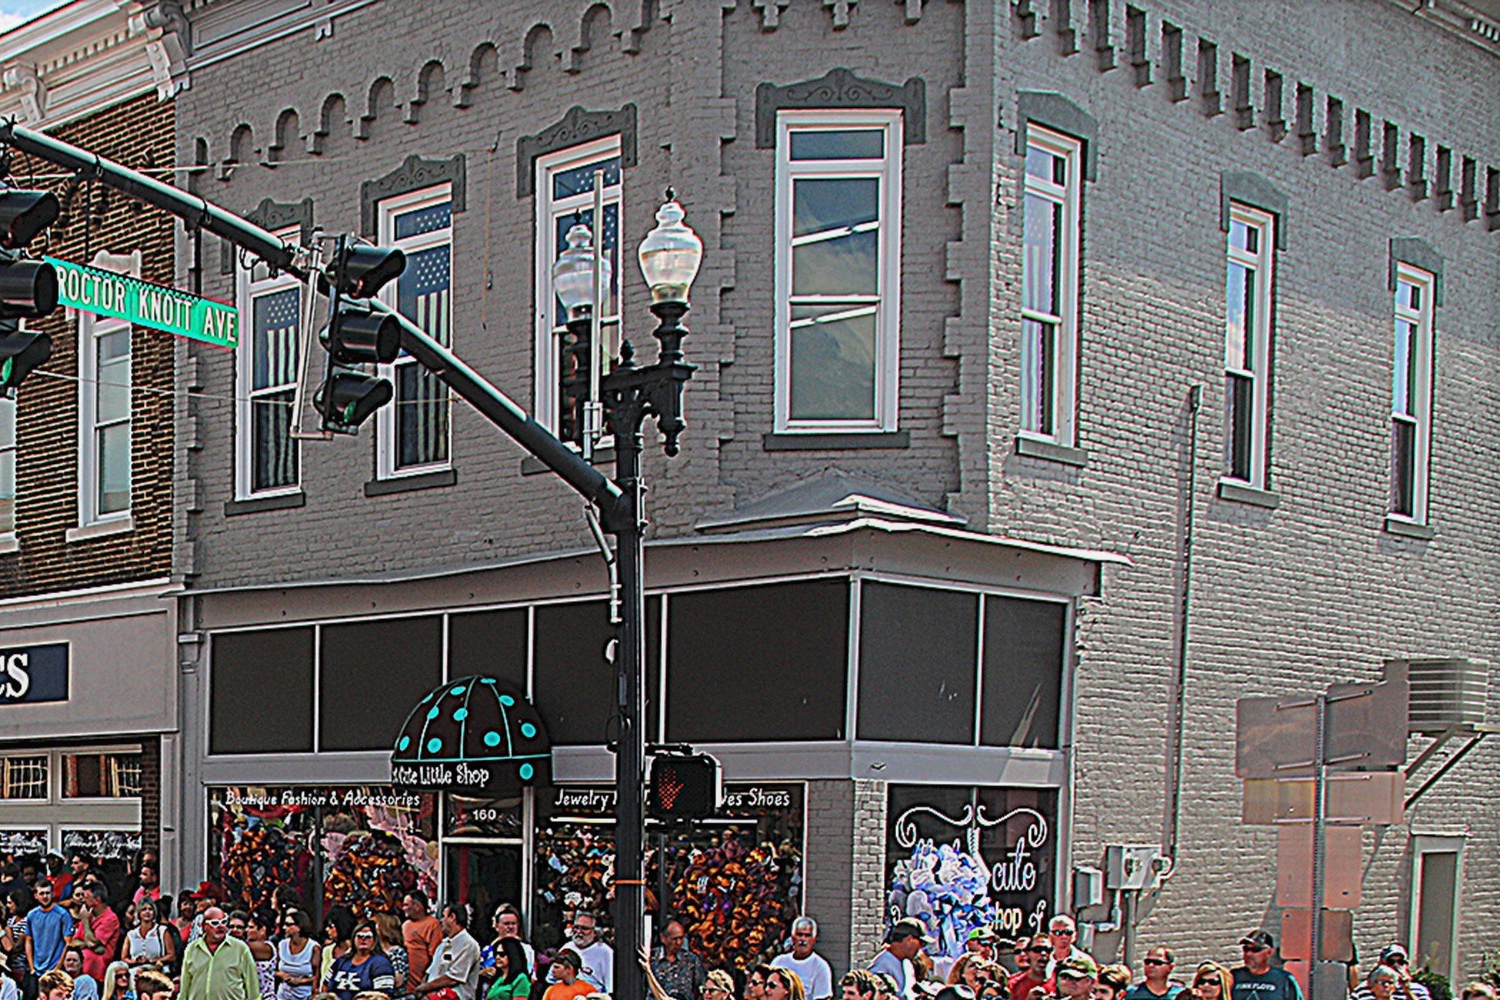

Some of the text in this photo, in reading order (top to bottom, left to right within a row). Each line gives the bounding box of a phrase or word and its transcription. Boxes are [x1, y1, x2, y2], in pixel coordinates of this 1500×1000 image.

[55, 265, 237, 342] ROCTOR KNOTT AVE
[419, 763, 452, 785] Little
[456, 762, 490, 788] Shop
[225, 791, 277, 811] Boutique
[281, 791, 326, 806] Fashion
[329, 791, 340, 806] &
[554, 788, 608, 812] Jewelry
[747, 787, 790, 807] Shoes
[472, 808, 497, 821] 160
